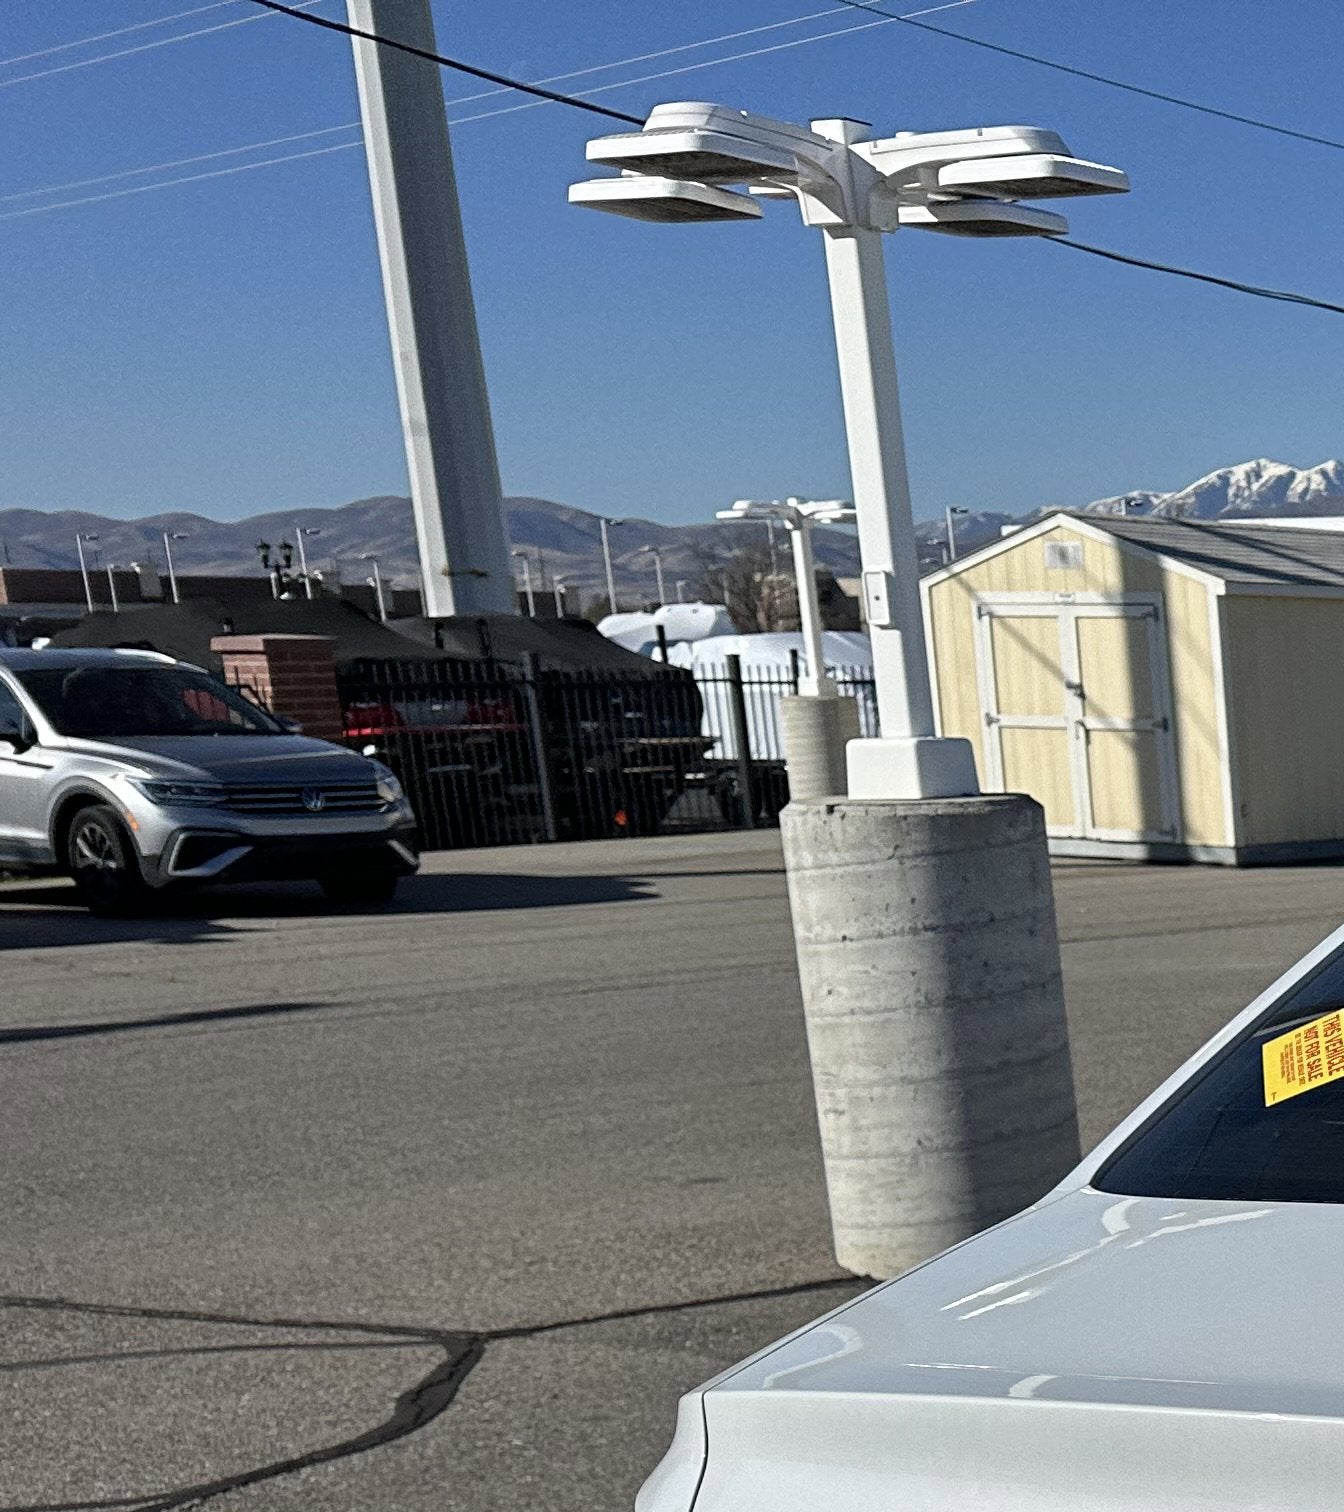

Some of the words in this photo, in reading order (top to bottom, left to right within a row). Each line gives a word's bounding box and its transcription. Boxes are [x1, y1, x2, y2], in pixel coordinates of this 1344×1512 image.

[1304, 1025, 1318, 1042] NOT
[1322, 1014, 1341, 1037] THIS
[1305, 1041, 1320, 1060] FOR
[1307, 1058, 1323, 1082] SALE
